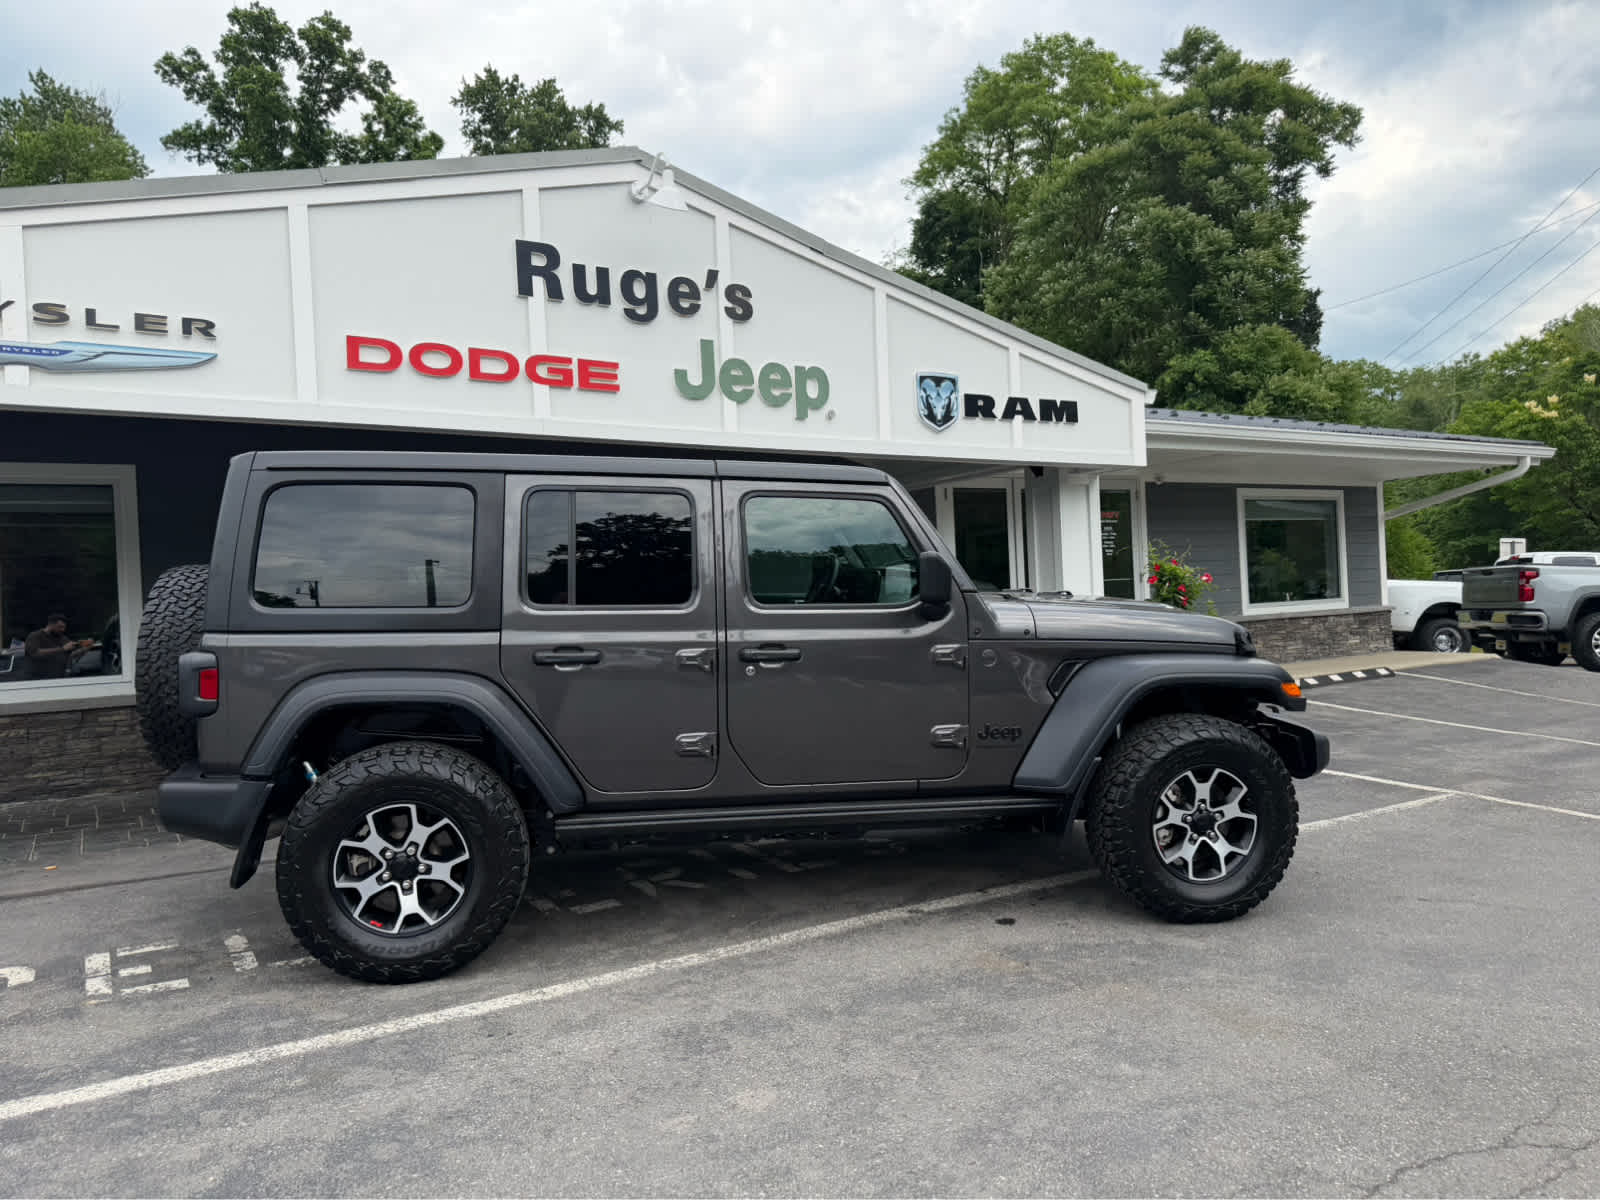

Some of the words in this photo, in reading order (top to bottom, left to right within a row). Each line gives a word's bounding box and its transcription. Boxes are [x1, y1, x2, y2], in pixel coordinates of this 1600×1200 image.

[515, 239, 754, 324] Ruge's
[346, 335, 620, 392] DODGE
[674, 339, 831, 421] Jeep
[963, 393, 1079, 423] RAM
[977, 723, 1022, 742] Jeep
